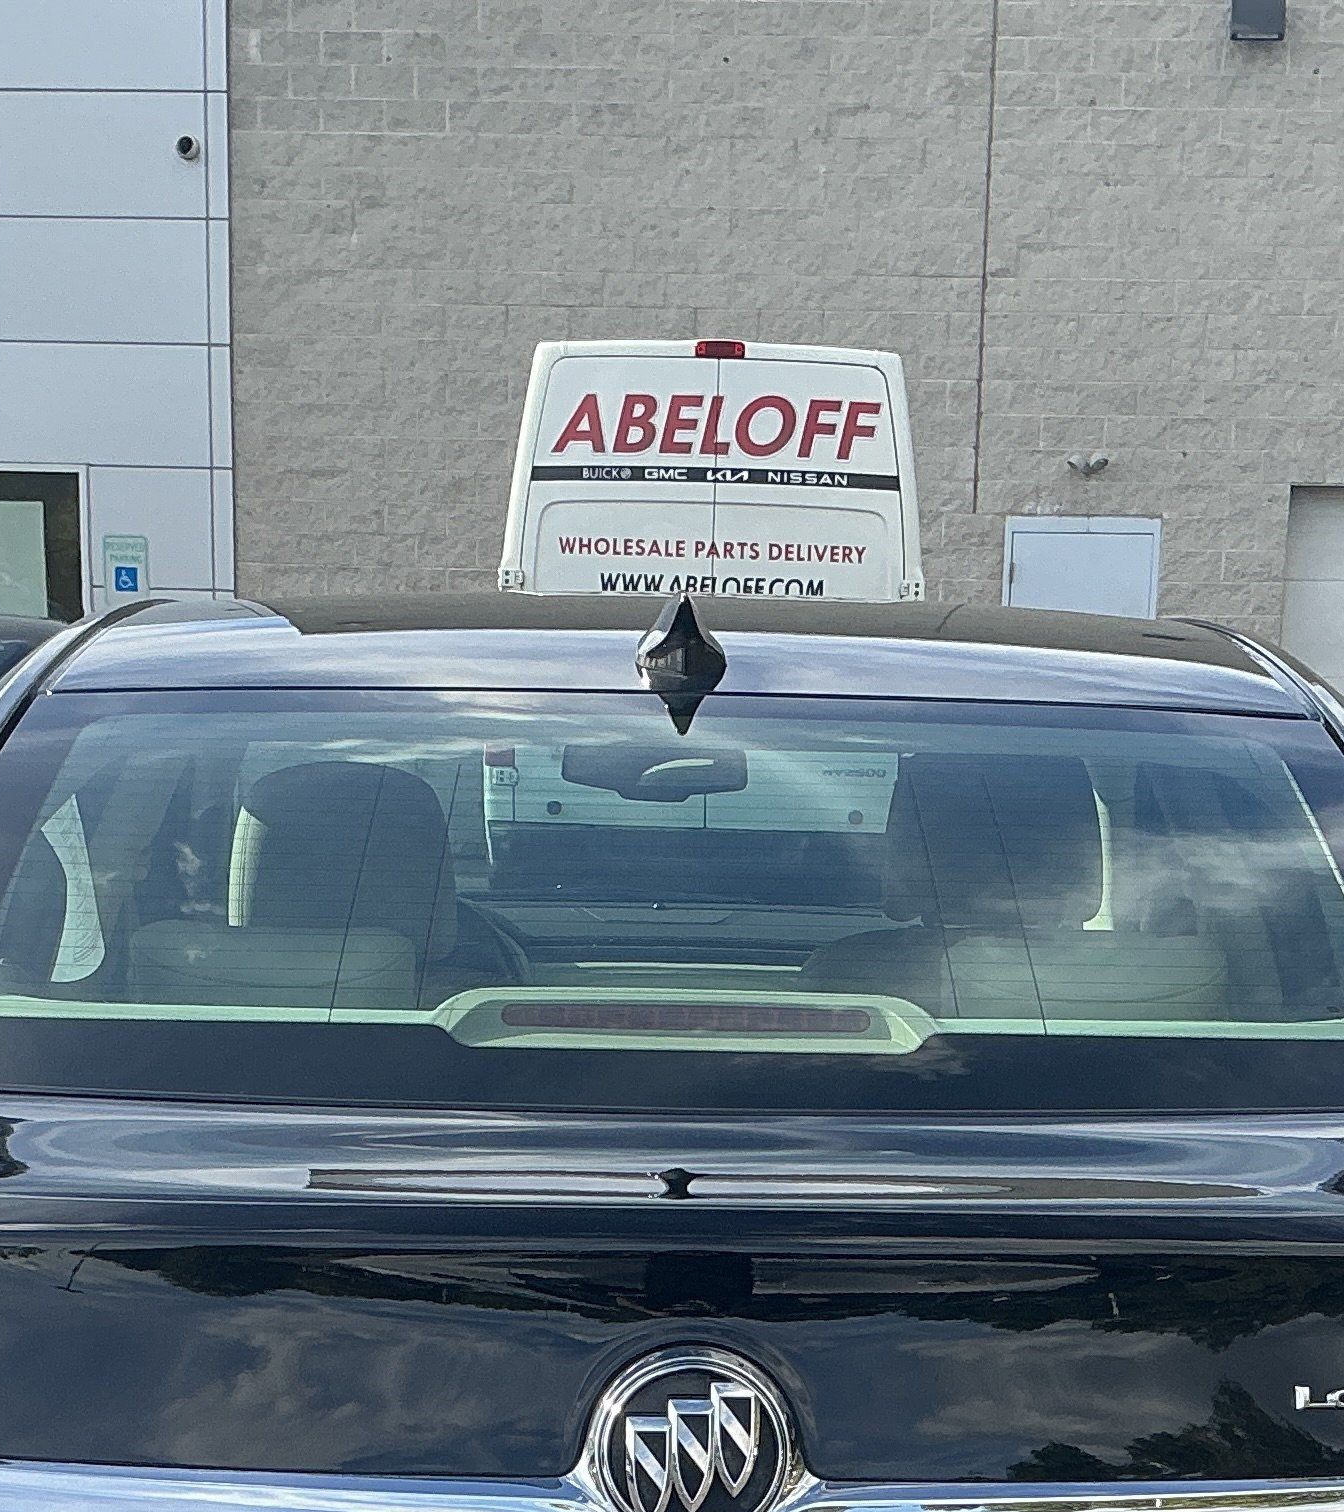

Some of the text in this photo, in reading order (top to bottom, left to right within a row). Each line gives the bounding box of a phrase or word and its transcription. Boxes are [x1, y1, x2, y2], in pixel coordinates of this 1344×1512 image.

[550, 392, 883, 461] ABELOFF
[582, 467, 848, 487] BUICK GMC KIA NISSAN
[558, 536, 867, 564] WHOLESALE PARTS DELIVERY
[600, 572, 824, 596] WWWABELOFFCOM
